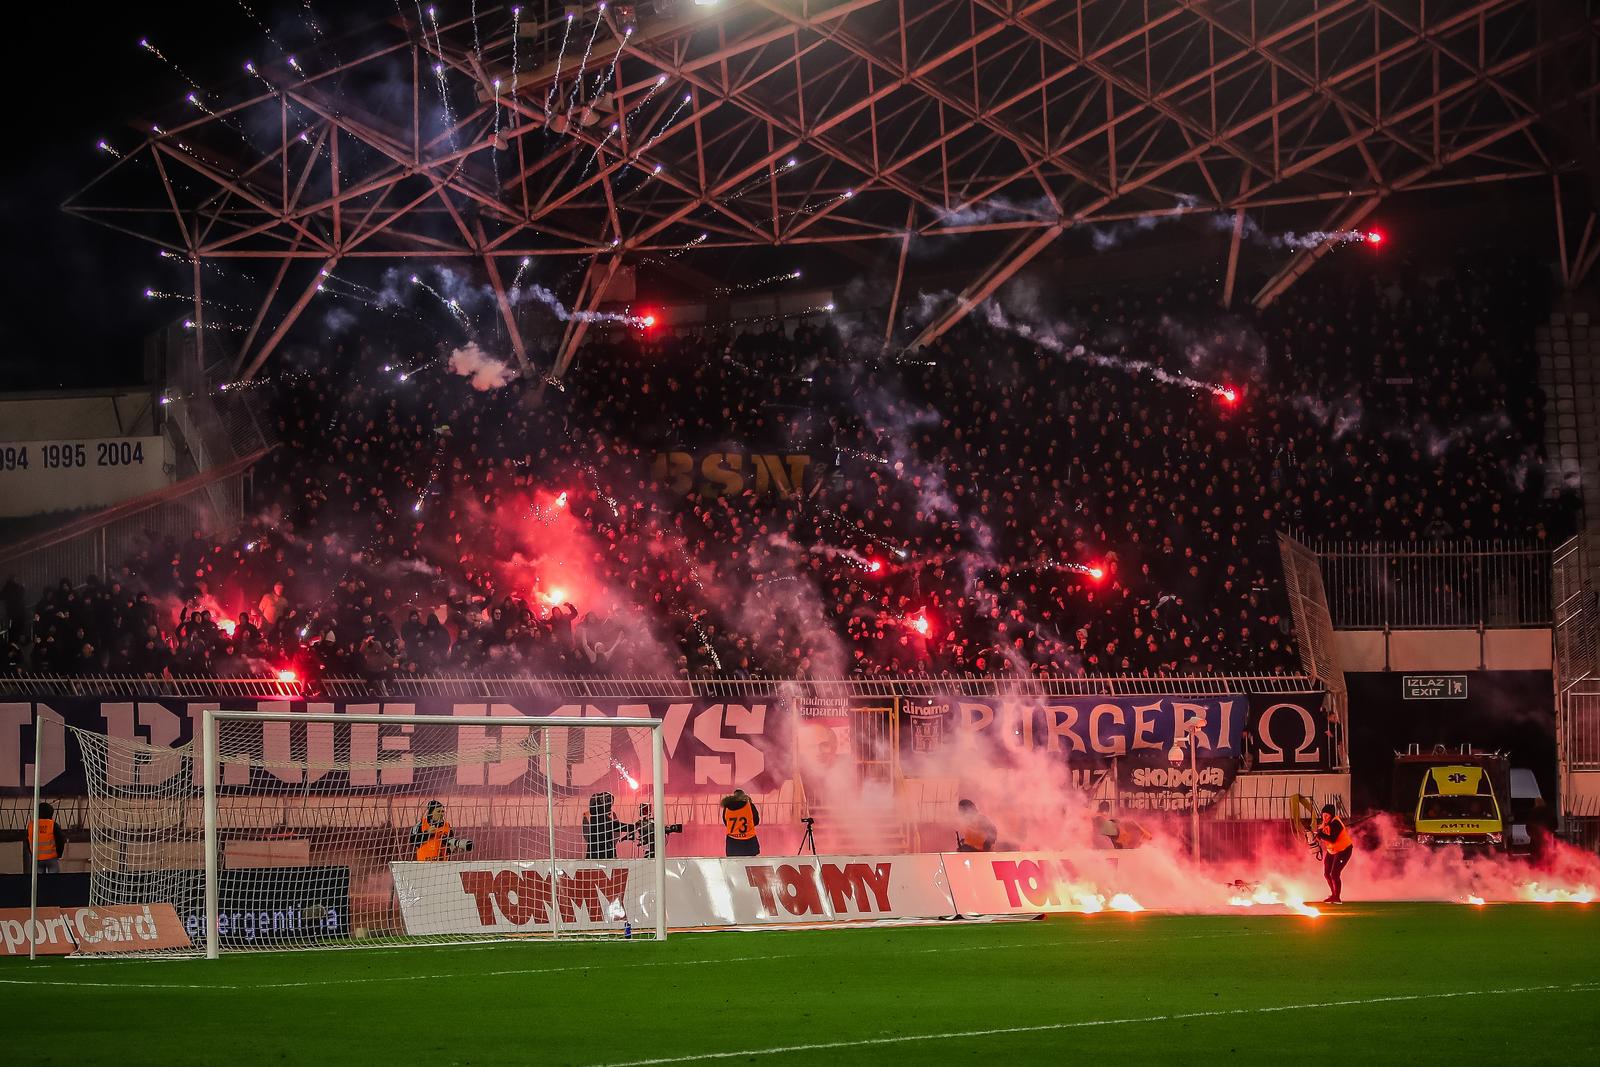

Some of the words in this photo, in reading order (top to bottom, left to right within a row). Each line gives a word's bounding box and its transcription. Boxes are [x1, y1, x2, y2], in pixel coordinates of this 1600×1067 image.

[41, 444, 86, 468] 1995
[97, 442, 144, 466] 2004
[1407, 679, 1445, 687] IZLAZ
[1411, 688, 1441, 696] EXIT
[800, 706, 848, 717] suparnik
[902, 699, 949, 715] dinamo
[958, 699, 1234, 756] PURGERI
[101, 701, 416, 787] BLUE
[453, 703, 766, 786] BOYS
[1133, 767, 1224, 788] sloboda
[729, 817, 747, 834] 73
[459, 868, 629, 926] TOMMY
[745, 862, 892, 917] TOMMY
[0, 905, 158, 954] portCard
